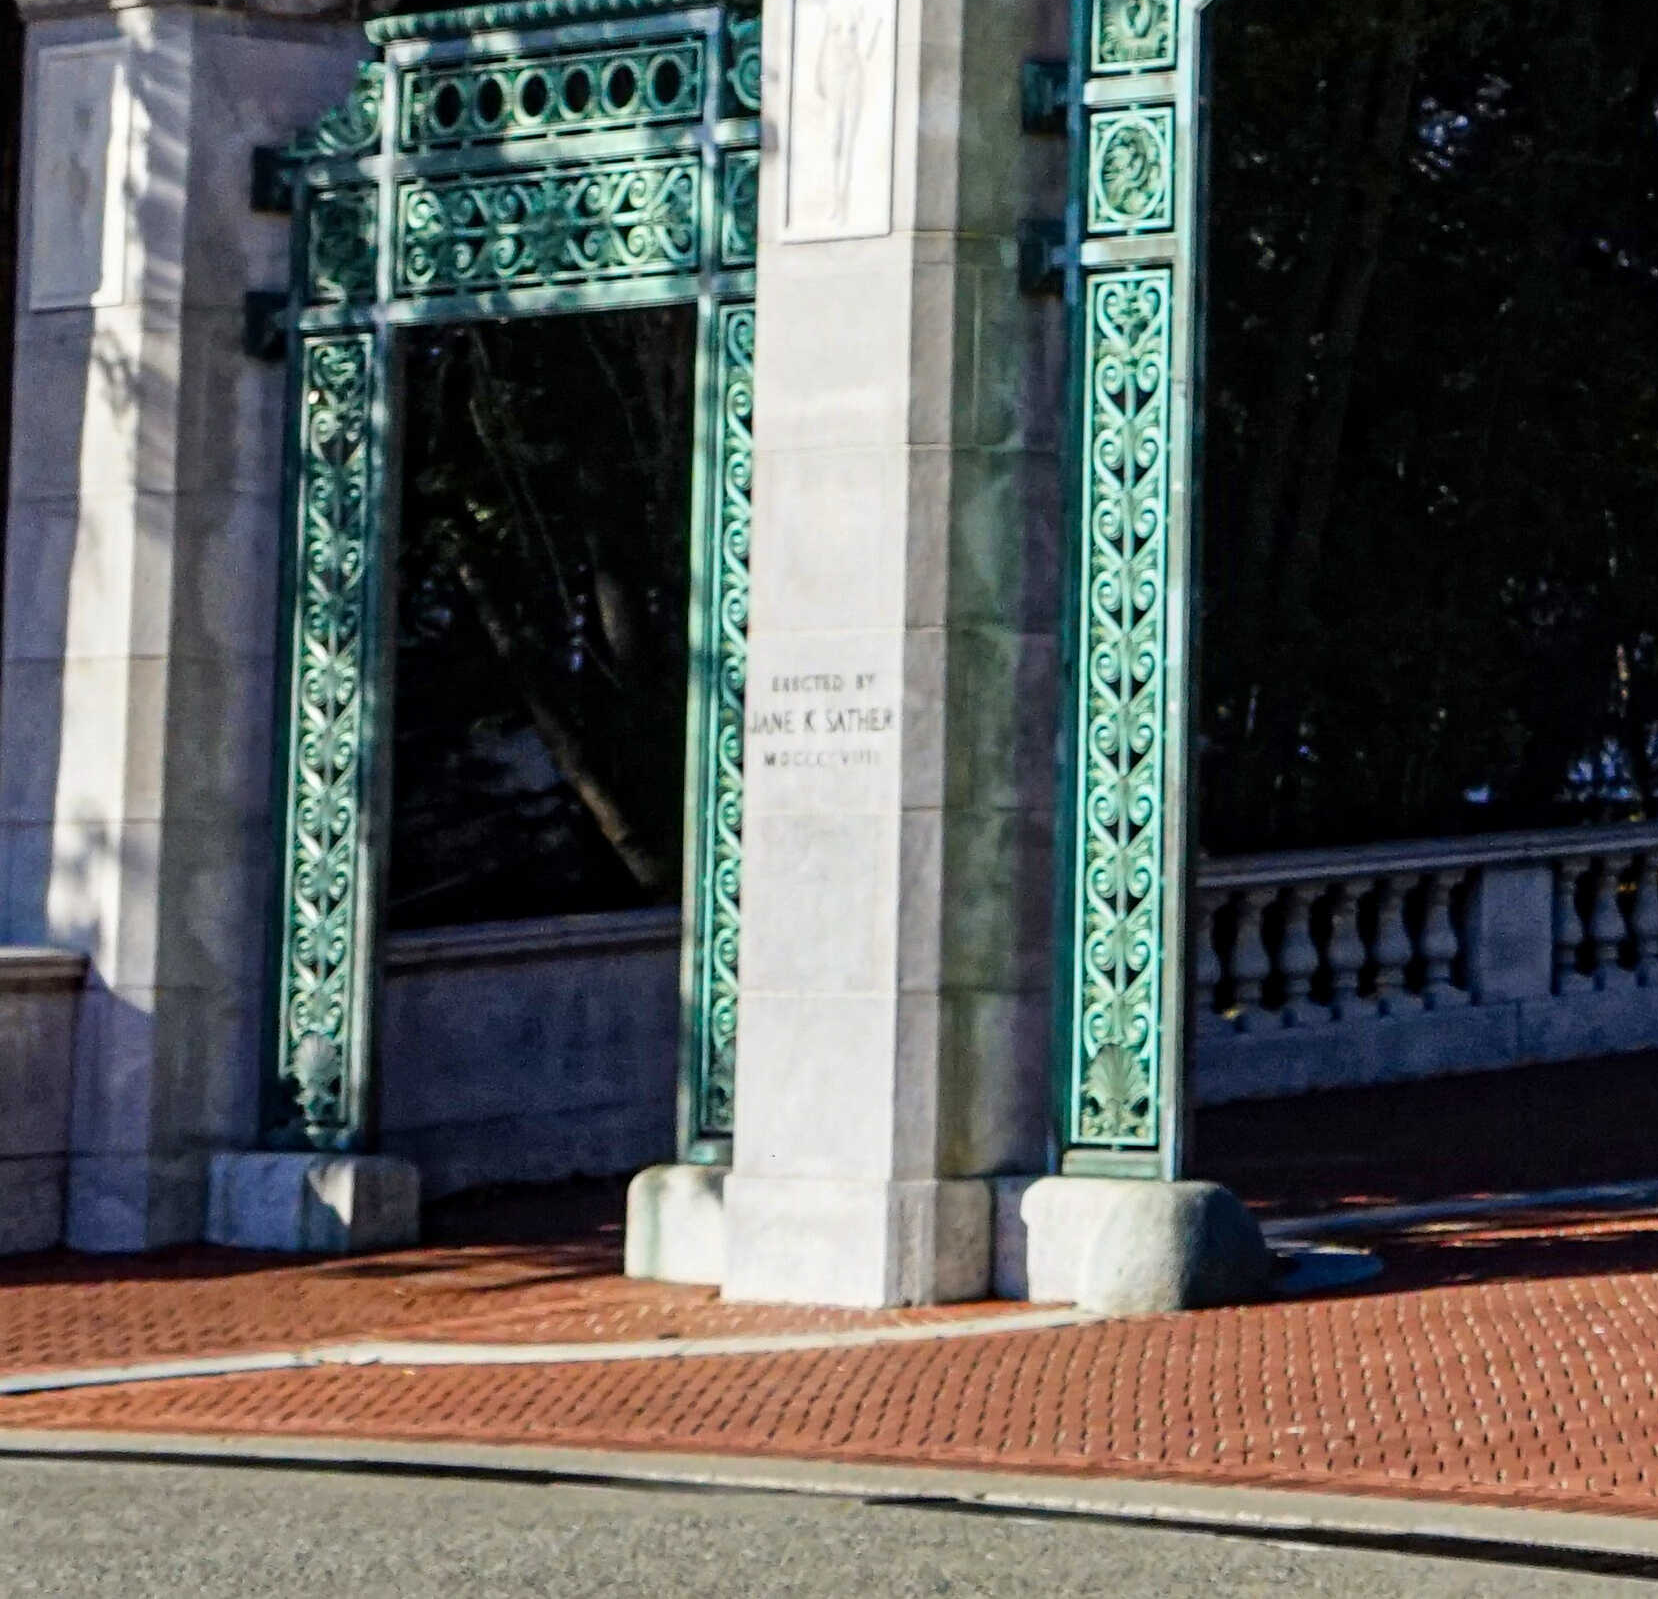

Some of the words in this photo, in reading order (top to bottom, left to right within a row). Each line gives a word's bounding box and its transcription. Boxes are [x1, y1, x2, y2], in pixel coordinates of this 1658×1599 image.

[771, 673, 846, 693] ERECTED
[855, 673, 876, 690] BY
[750, 710, 796, 735] JANE
[825, 708, 894, 733] SATHER
